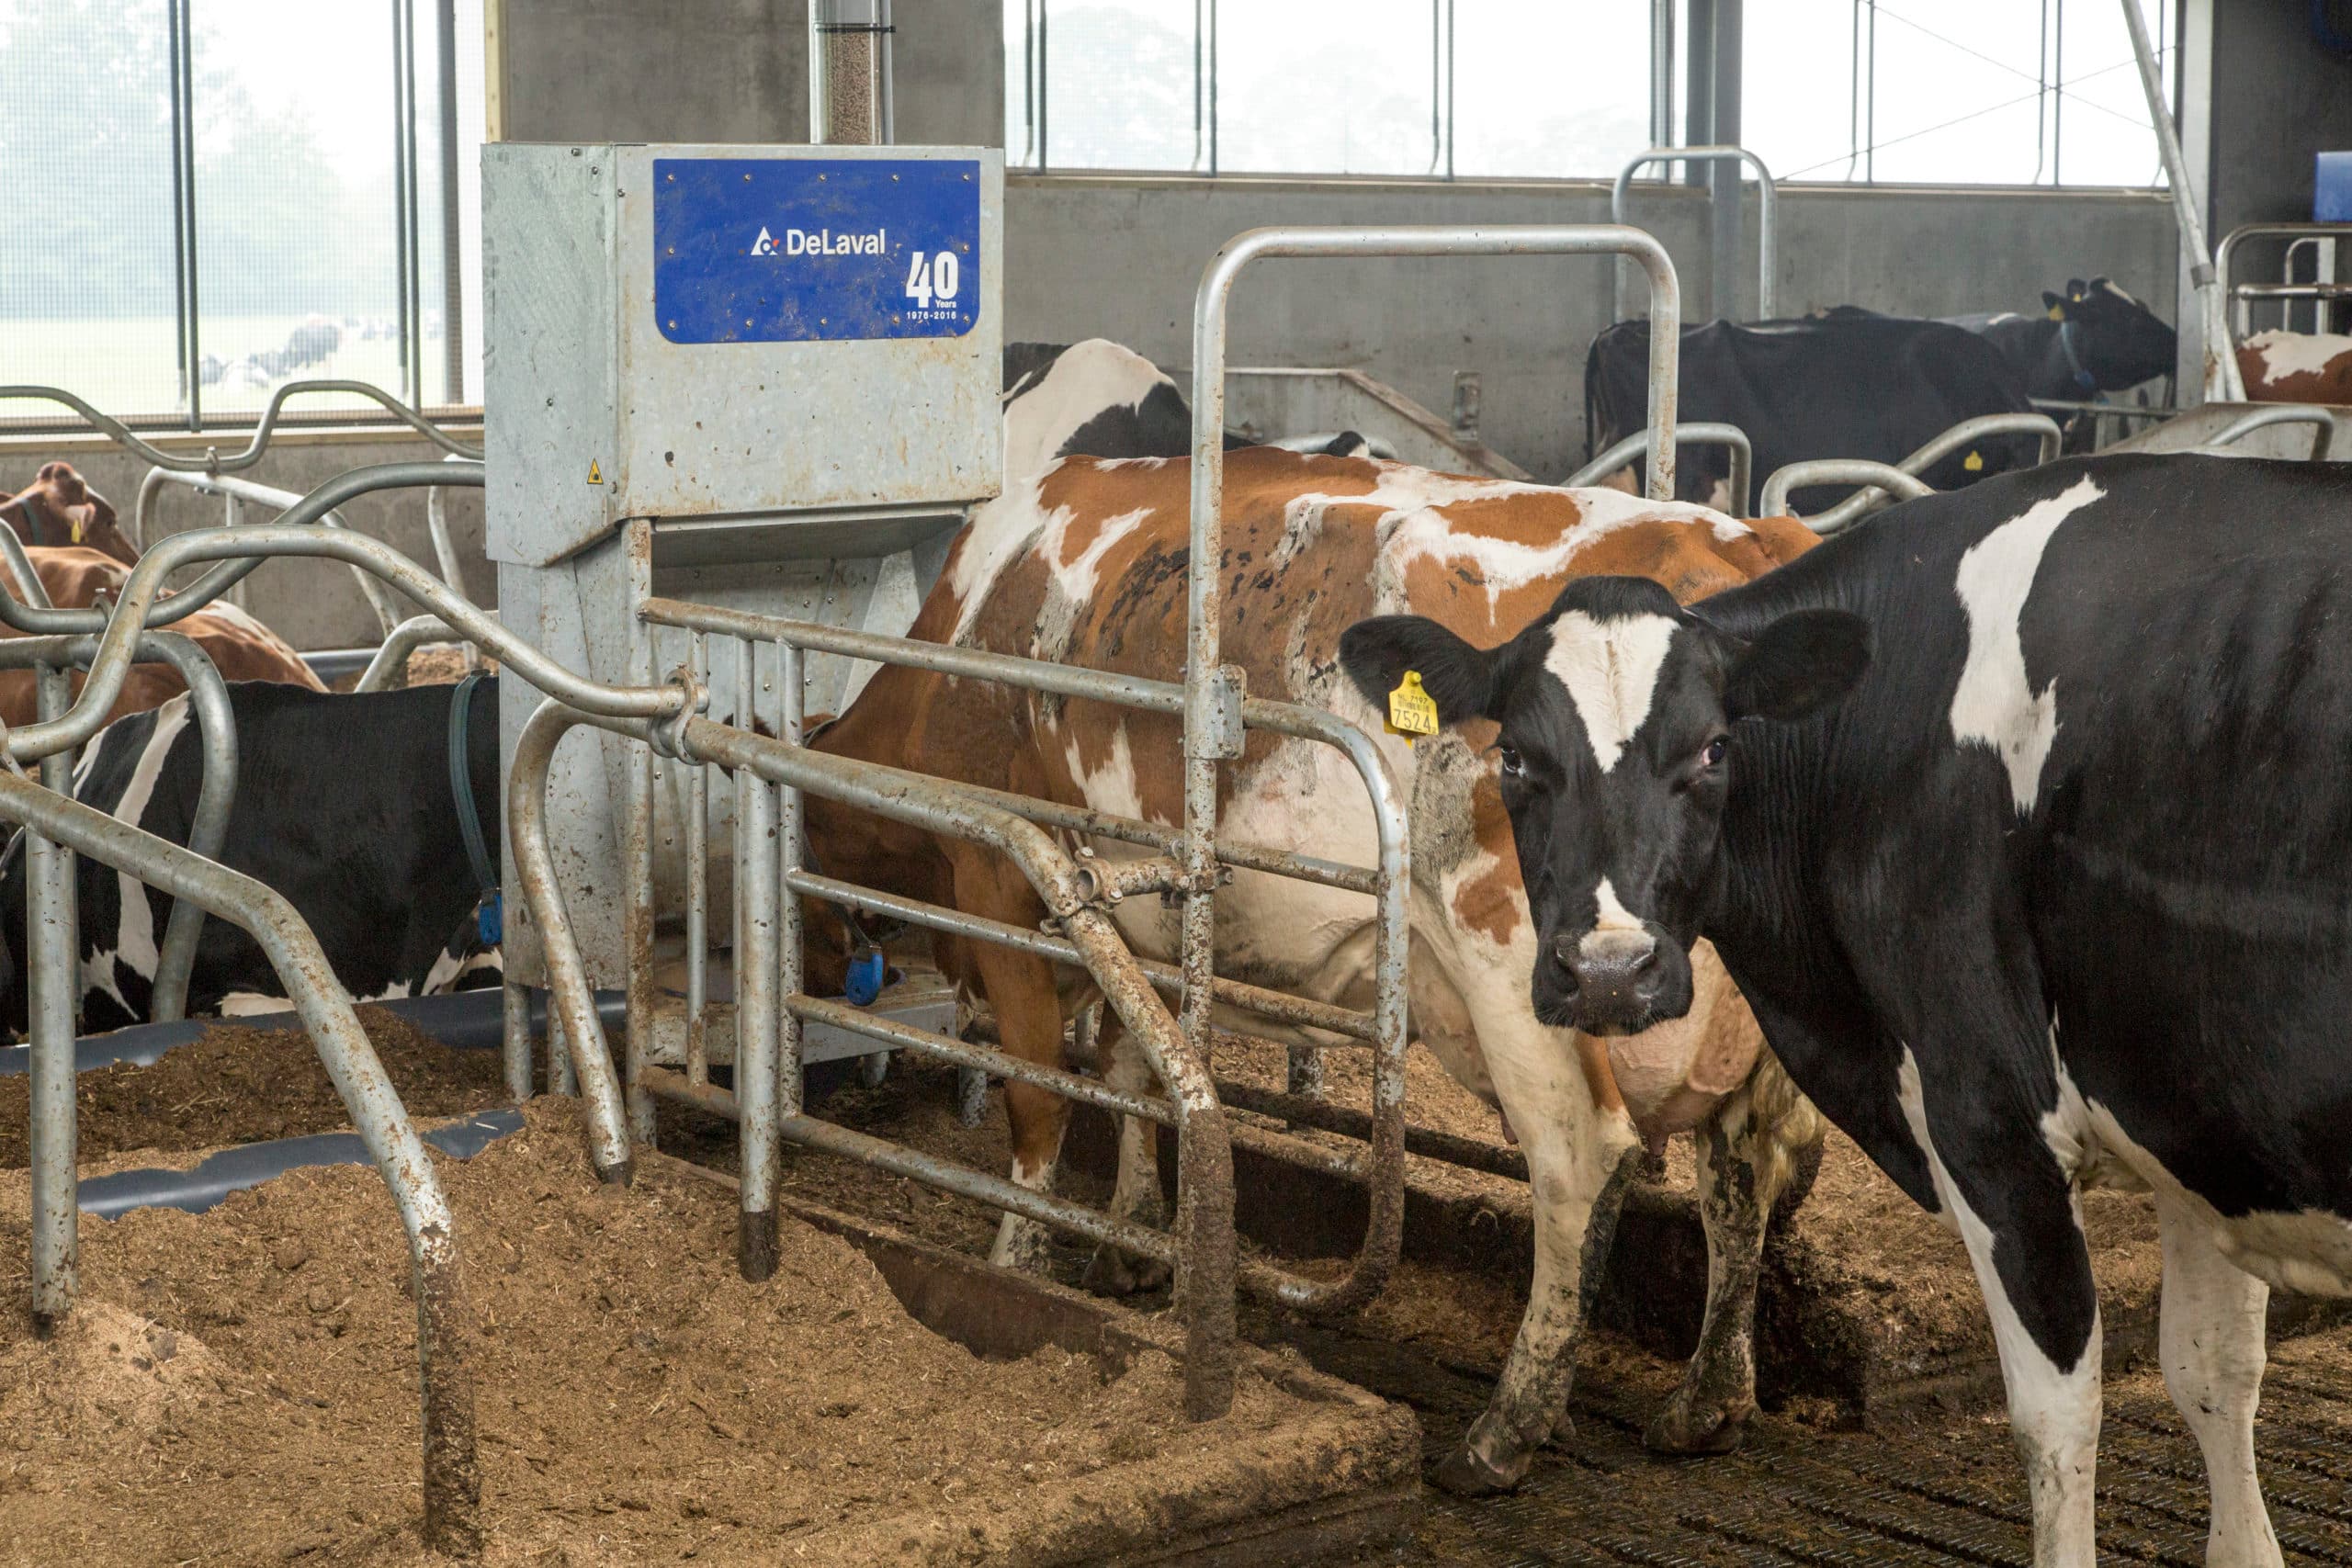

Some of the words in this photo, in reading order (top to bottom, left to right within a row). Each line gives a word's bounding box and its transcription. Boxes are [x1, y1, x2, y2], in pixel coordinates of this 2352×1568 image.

[787, 229, 885, 255] DeLaval
[906, 251, 958, 308] 40
[935, 299, 956, 309] Years
[1394, 709, 1431, 733] 7524
